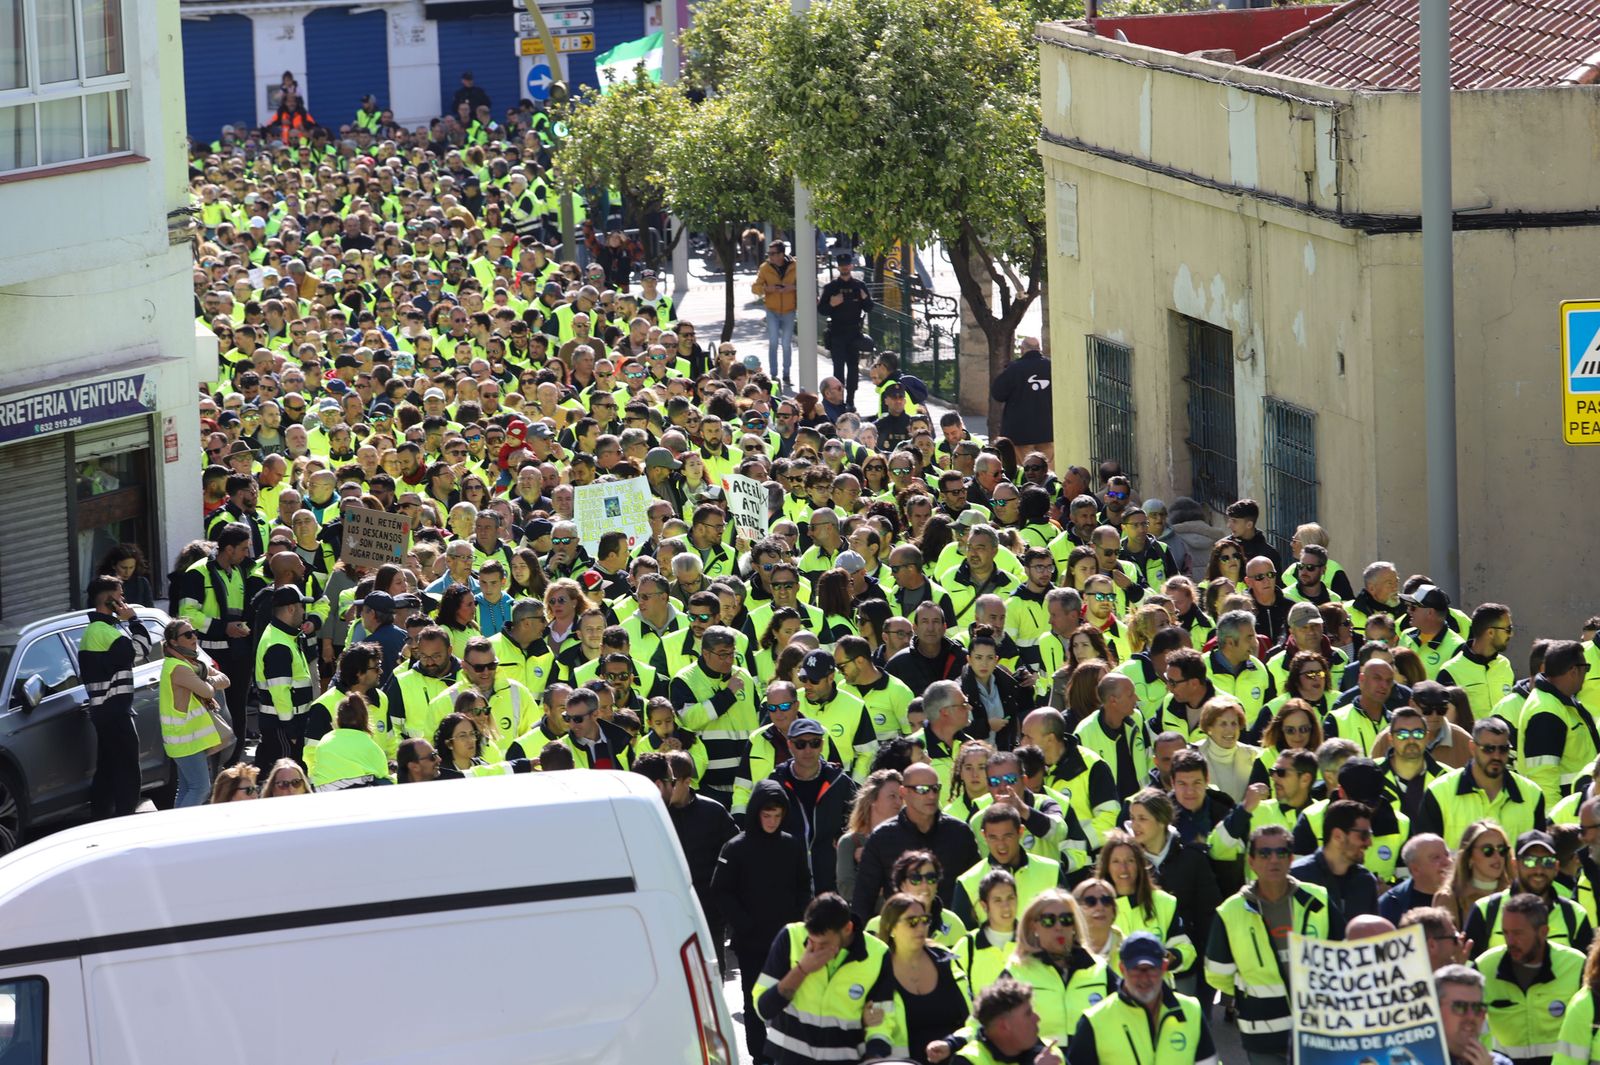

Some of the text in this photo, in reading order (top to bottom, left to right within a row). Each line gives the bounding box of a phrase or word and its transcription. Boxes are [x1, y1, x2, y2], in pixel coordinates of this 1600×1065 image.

[69, 379, 138, 412] VENTURA
[1577, 400, 1600, 414] PA
[55, 419, 67, 429] 519
[365, 516, 374, 526] AL
[348, 525, 402, 544] LOS DESCANSOS
[349, 548, 371, 558] JUGAR
[371, 551, 385, 561] CON
[359, 538, 393, 552] SON PARA
[1301, 934, 1415, 972] ACERINOX
[1309, 965, 1405, 993] ESCUCHA
[1325, 1014, 1352, 1029] LA
[1364, 1001, 1433, 1028] LUCHA
[1301, 1026, 1436, 1051] FAMILIAS DE ACERO
